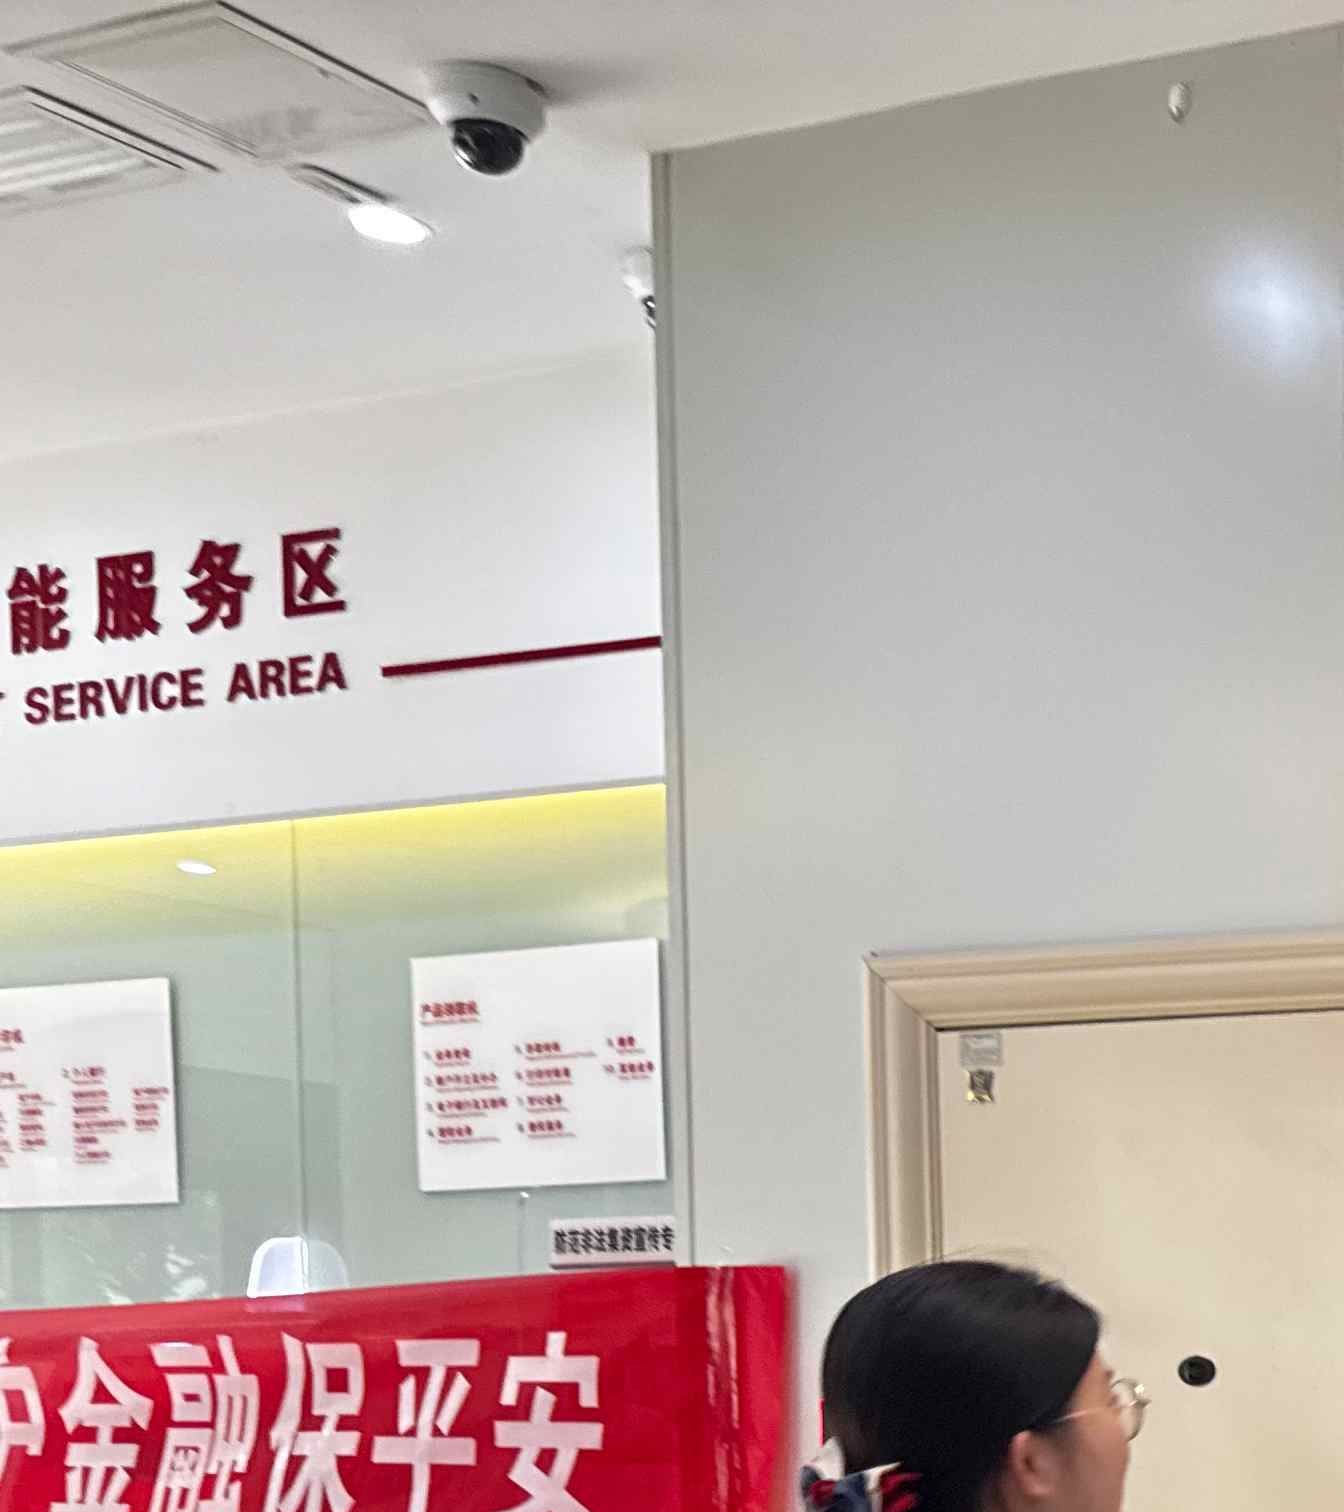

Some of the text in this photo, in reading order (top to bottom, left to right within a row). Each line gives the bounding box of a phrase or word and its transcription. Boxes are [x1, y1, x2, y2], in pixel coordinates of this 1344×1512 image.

[6, 527, 348, 655] 能服务区
[24, 652, 349, 726] SERVICE AREA
